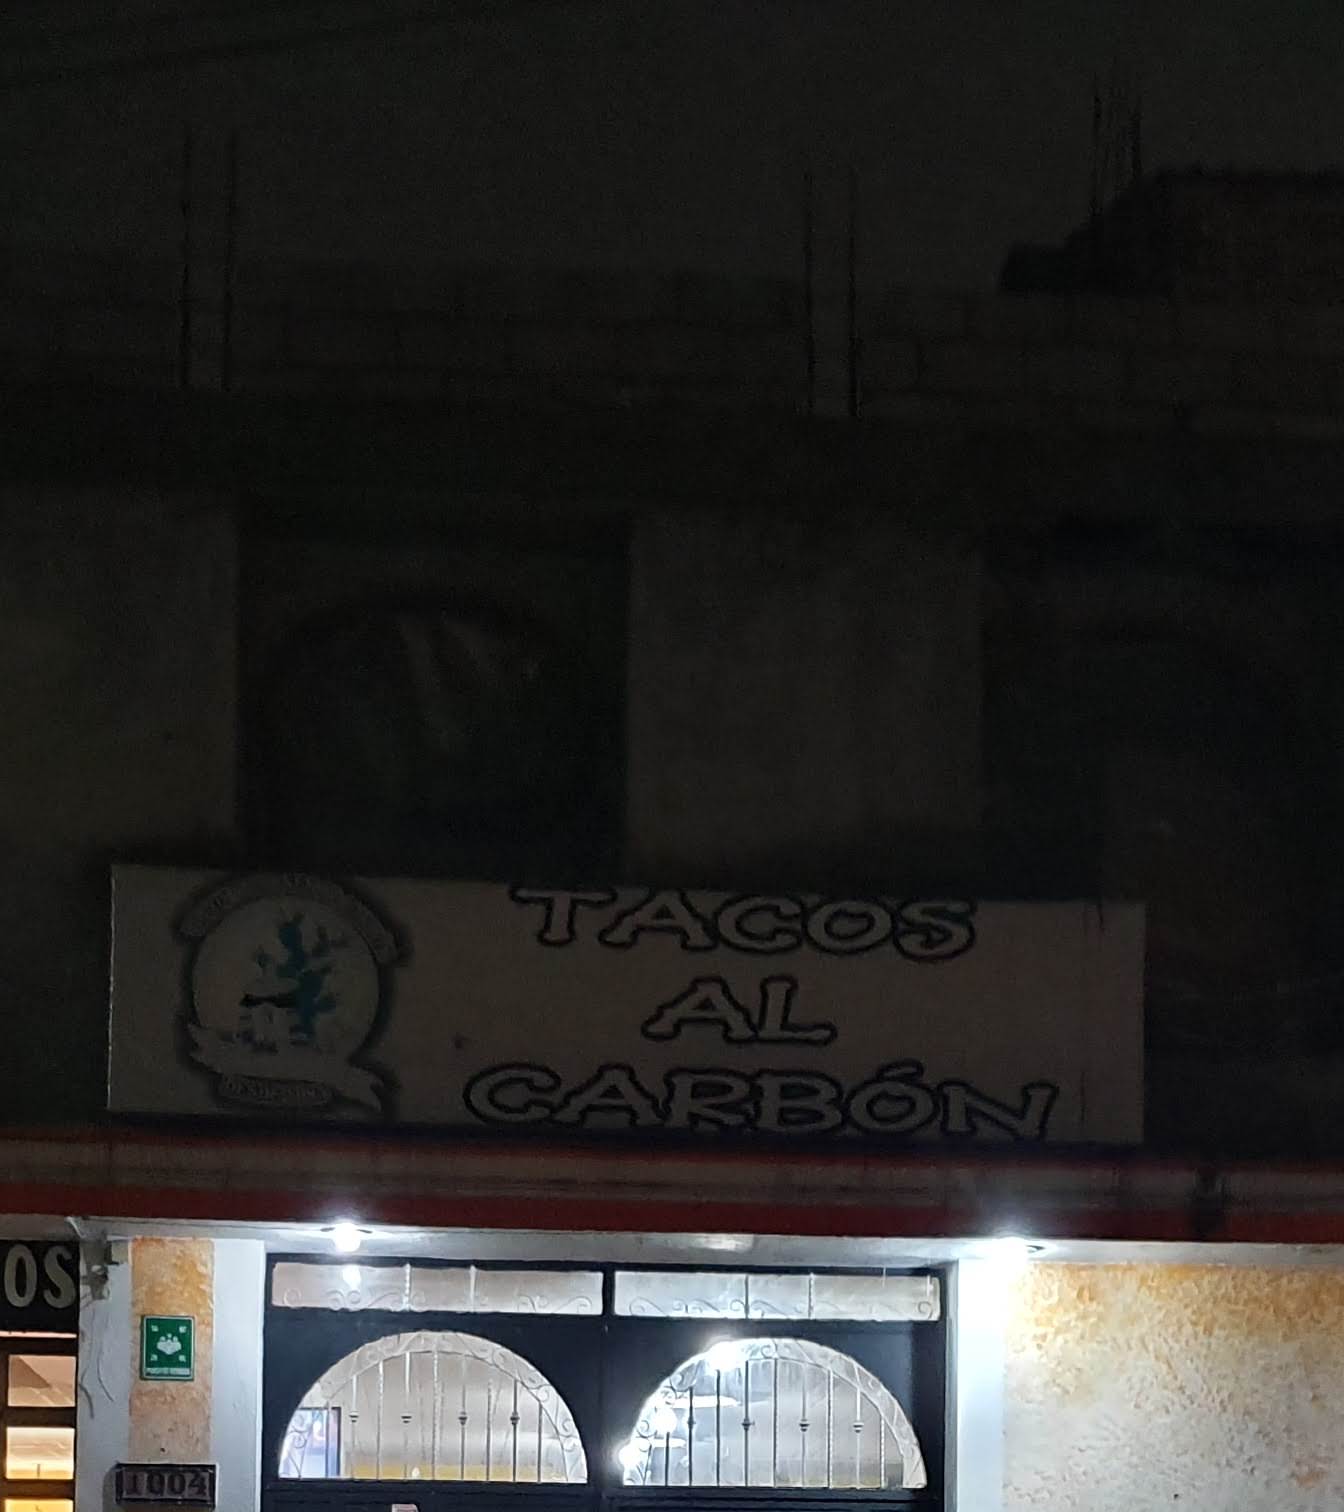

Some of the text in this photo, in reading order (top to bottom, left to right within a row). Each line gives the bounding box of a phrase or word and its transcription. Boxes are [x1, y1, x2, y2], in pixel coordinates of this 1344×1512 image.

[509, 885, 977, 962] TACOS
[641, 975, 837, 1046] AL
[463, 1059, 1058, 1140] CARBÓN
[125, 1469, 208, 1497] 1004
